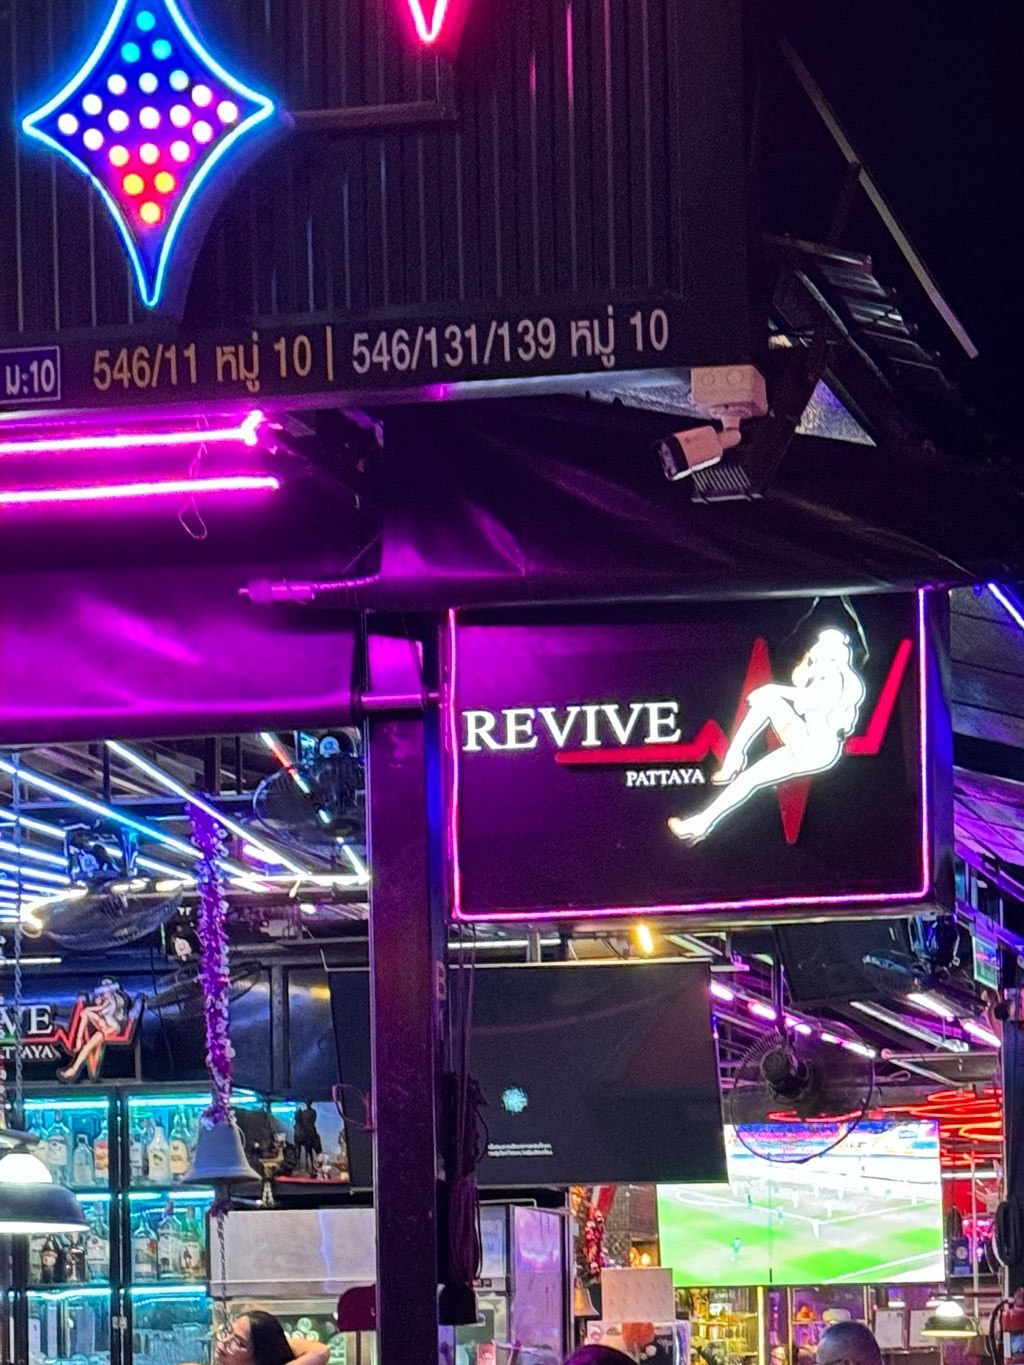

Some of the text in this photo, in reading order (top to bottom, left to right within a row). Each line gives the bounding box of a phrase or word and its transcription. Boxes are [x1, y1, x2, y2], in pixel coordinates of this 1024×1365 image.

[94, 305, 668, 393] 546/11 หมู่ 10 546/131/139 หมู่ 10
[461, 702, 681, 751] REVIVE
[626, 768, 705, 787] PATTAYA
